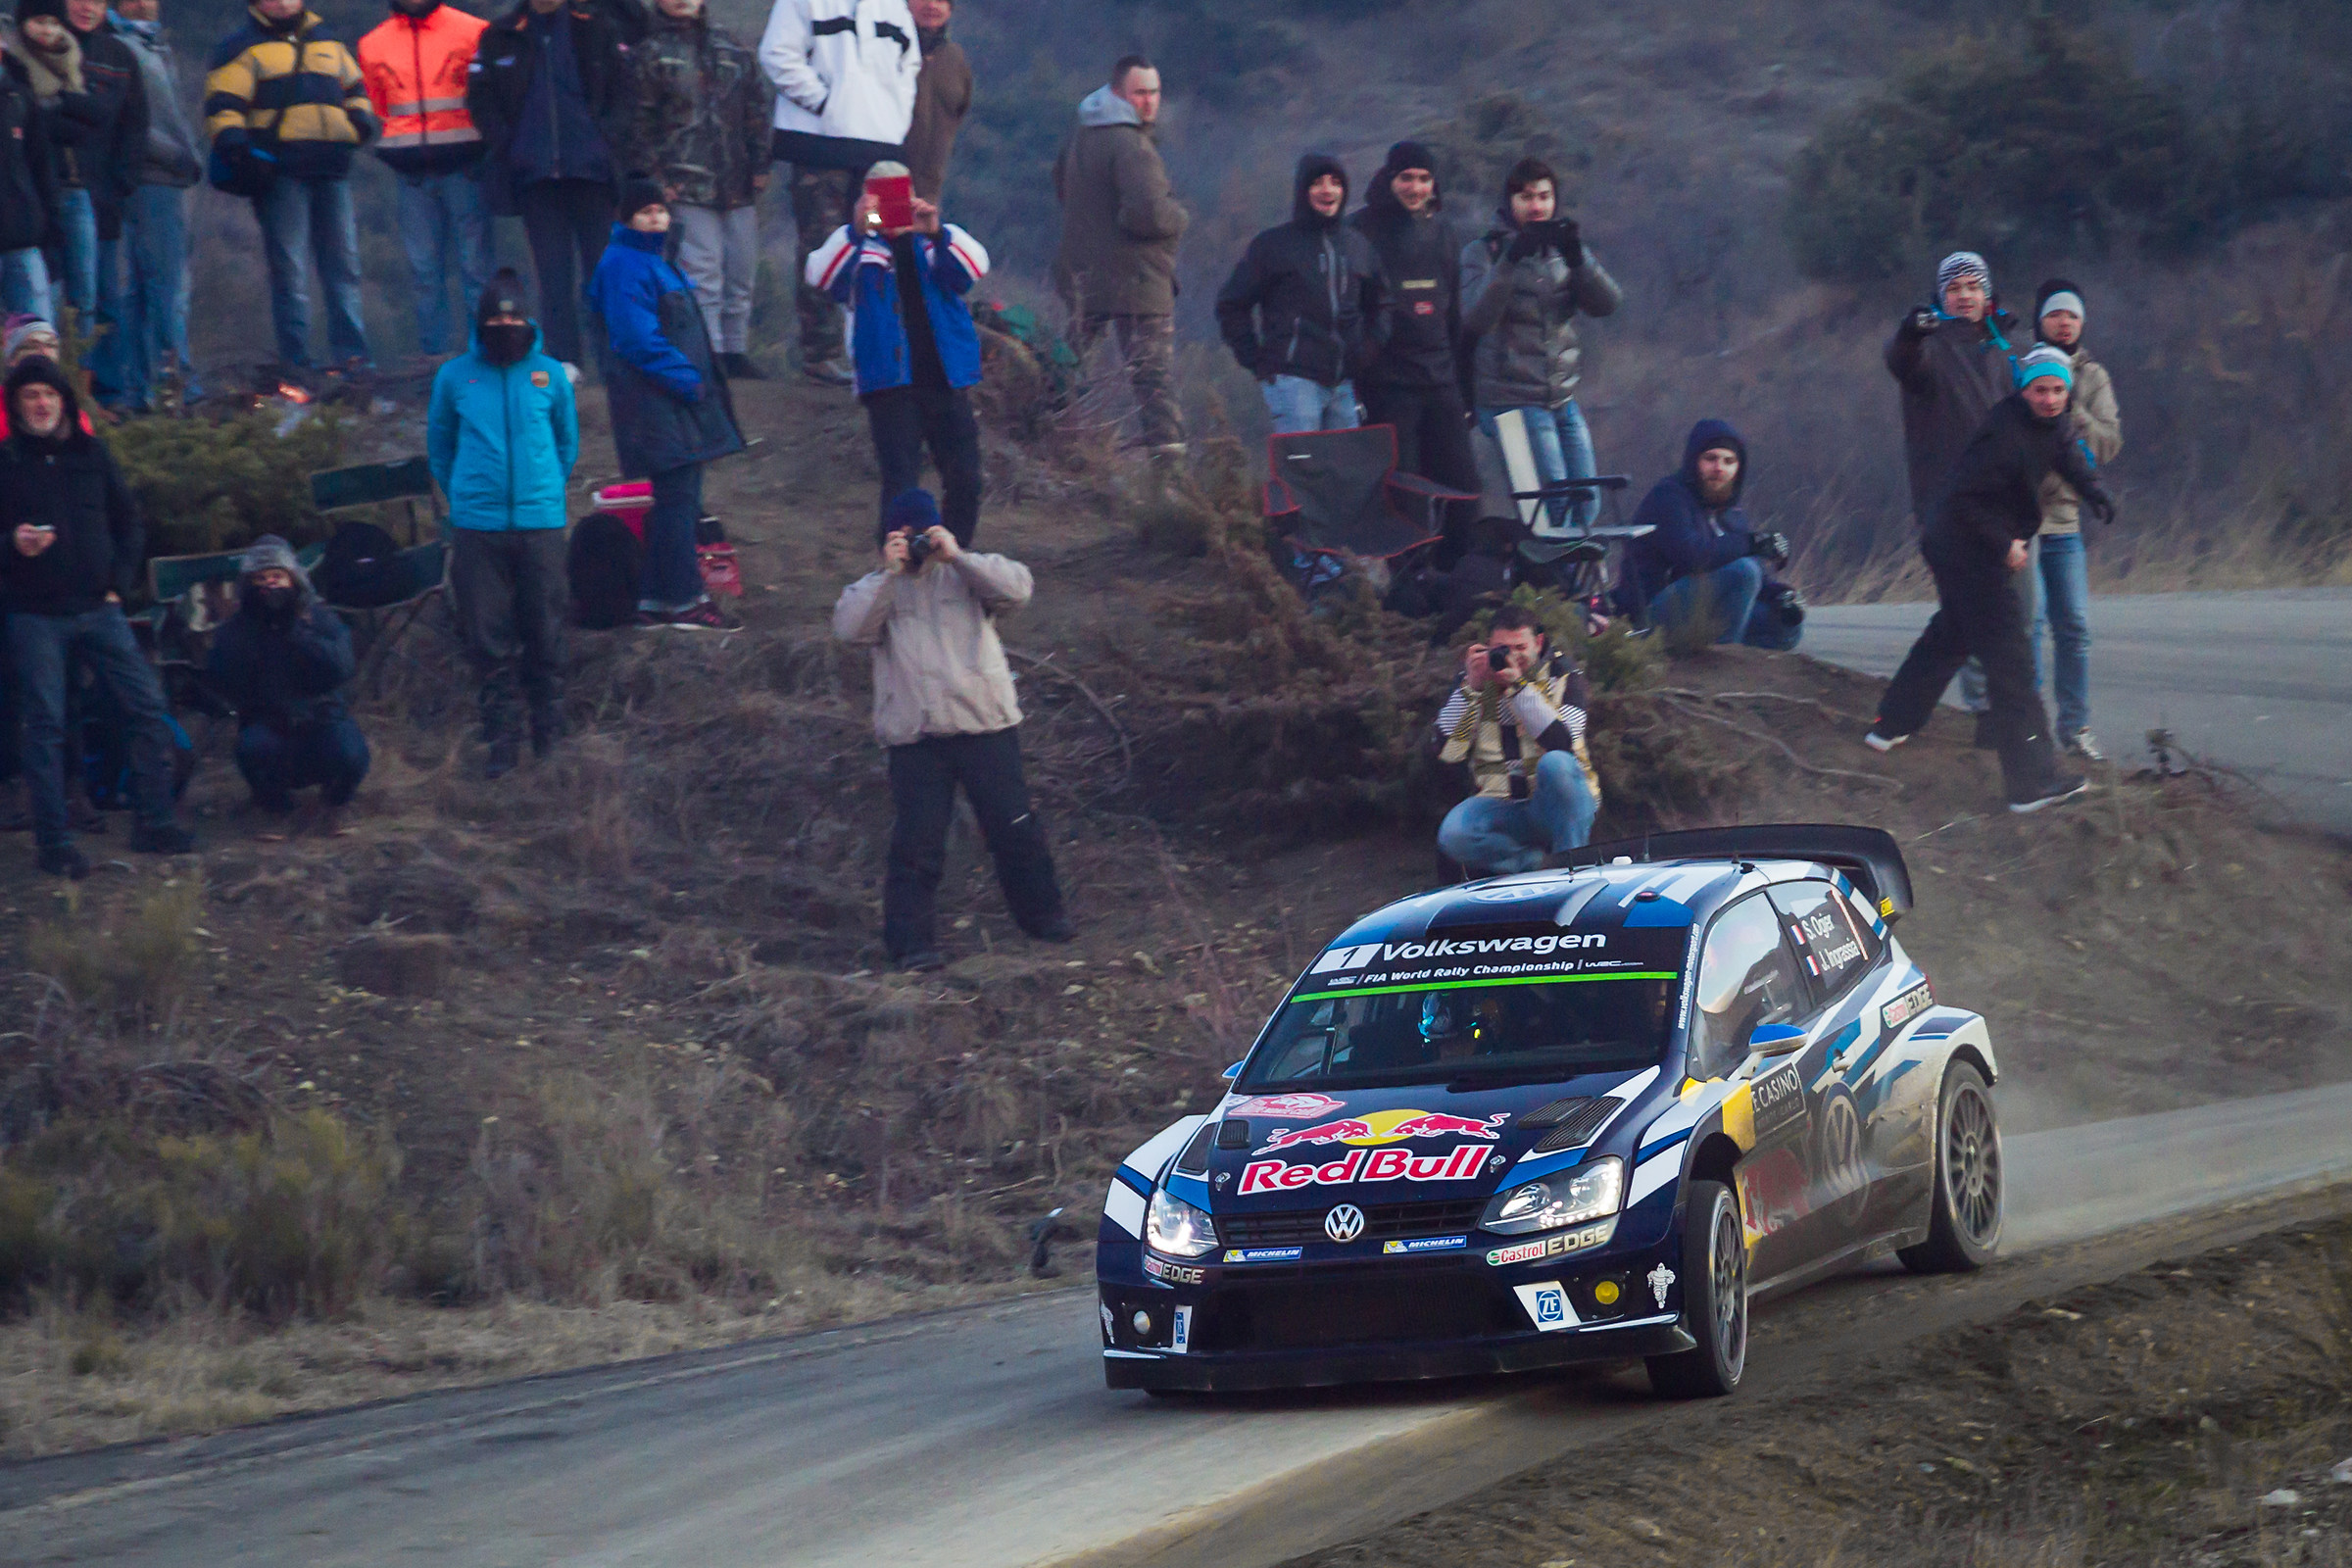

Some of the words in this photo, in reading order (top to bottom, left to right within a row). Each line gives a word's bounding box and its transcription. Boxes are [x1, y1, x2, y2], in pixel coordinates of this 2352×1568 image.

[1801, 920, 1816, 940] S.
[1811, 912, 1836, 938] Ogier
[1342, 946, 1360, 968] 1
[1383, 933, 1606, 961] Volkswagen
[1819, 951, 1830, 971] J.
[1825, 937, 1861, 969] Ingrassia
[1364, 973, 1387, 983] FIA
[1392, 969, 1432, 981] World
[1434, 966, 1470, 978] Rally
[1473, 961, 1574, 975] Championship
[1678, 922, 1700, 1029] www.volkswagen-motorsport.com
[1759, 1069, 1798, 1108] CASINO
[1239, 1150, 1365, 1194] Red
[1361, 1146, 1491, 1181] Bull
[1247, 1249, 1300, 1257] MICHELIN
[1408, 1237, 1464, 1249] MICHELIN
[1500, 1243, 1544, 1263] Castrol
[1547, 1224, 1609, 1255] EDGE
[1162, 1263, 1206, 1285] EDGE
